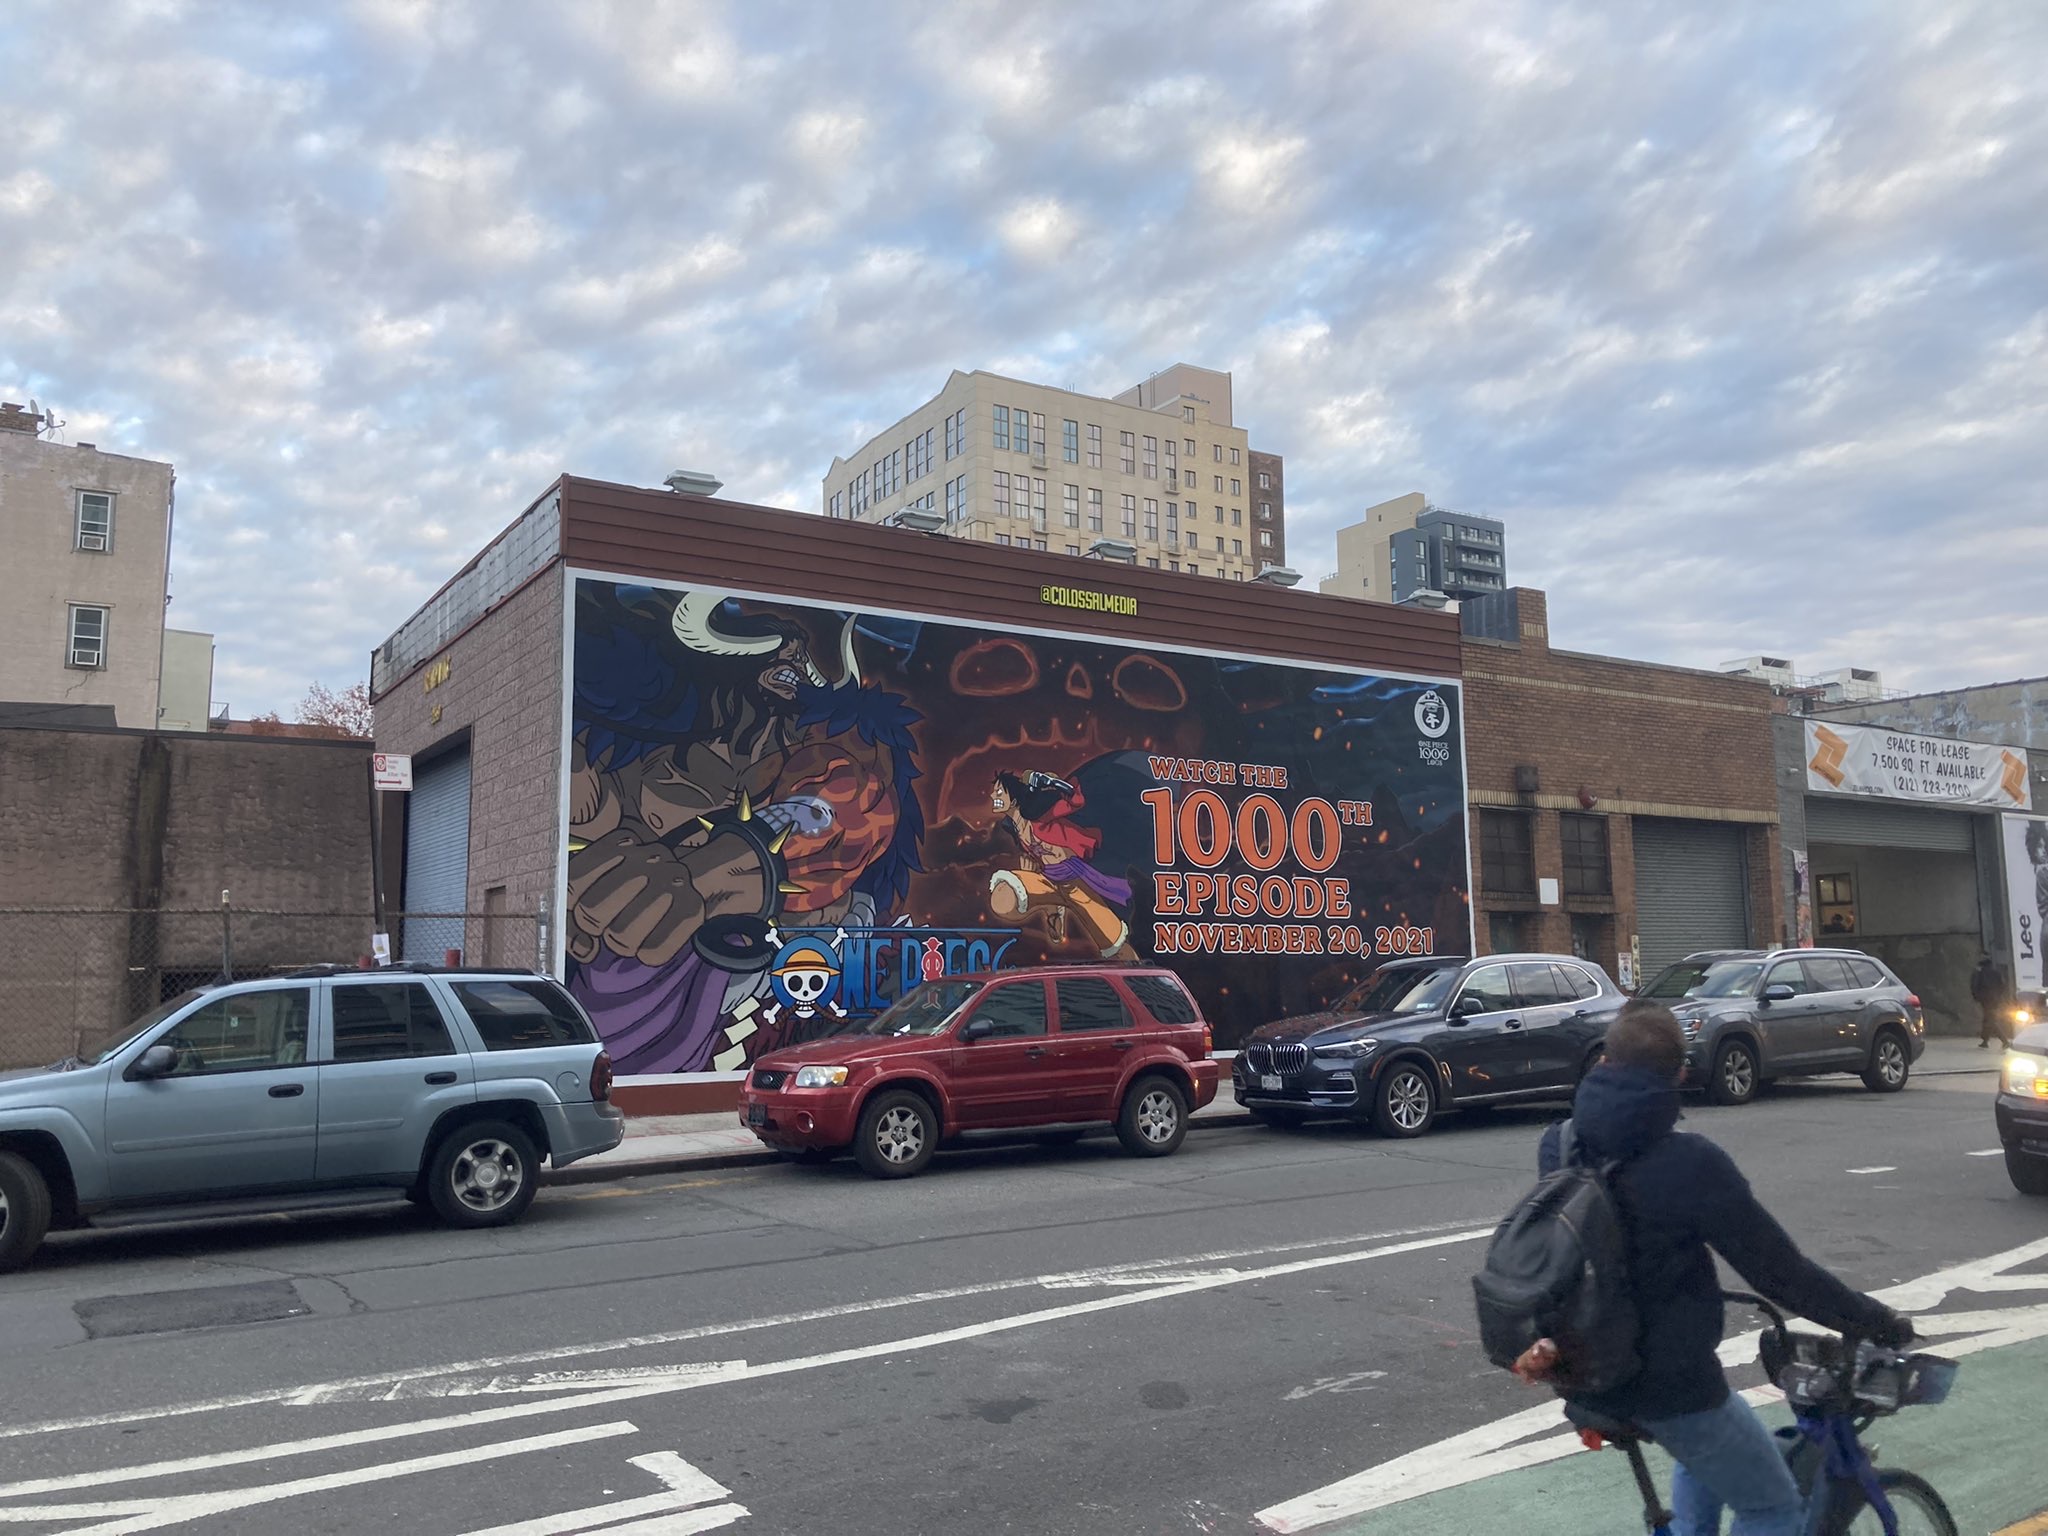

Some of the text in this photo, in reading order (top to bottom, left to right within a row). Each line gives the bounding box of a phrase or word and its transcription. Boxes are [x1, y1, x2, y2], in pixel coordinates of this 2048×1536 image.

[1041, 584, 1137, 616] @COLOSSALMEDIA
[1418, 740, 1449, 749] ONE PIECE
[1419, 748, 1449, 760] 1000
[1887, 736, 1970, 760] SPACE FOR LEASE
[1148, 756, 1288, 789] WATCH THE
[1937, 762, 1986, 780] AVAILABLE
[1893, 775, 1919, 792] (212)
[1922, 779, 1972, 798] 223-2200
[1153, 872, 1352, 920] EPISODE
[1153, 922, 1434, 959] NOVEMBER 20, 2021
[2019, 914, 2034, 960] Lee
